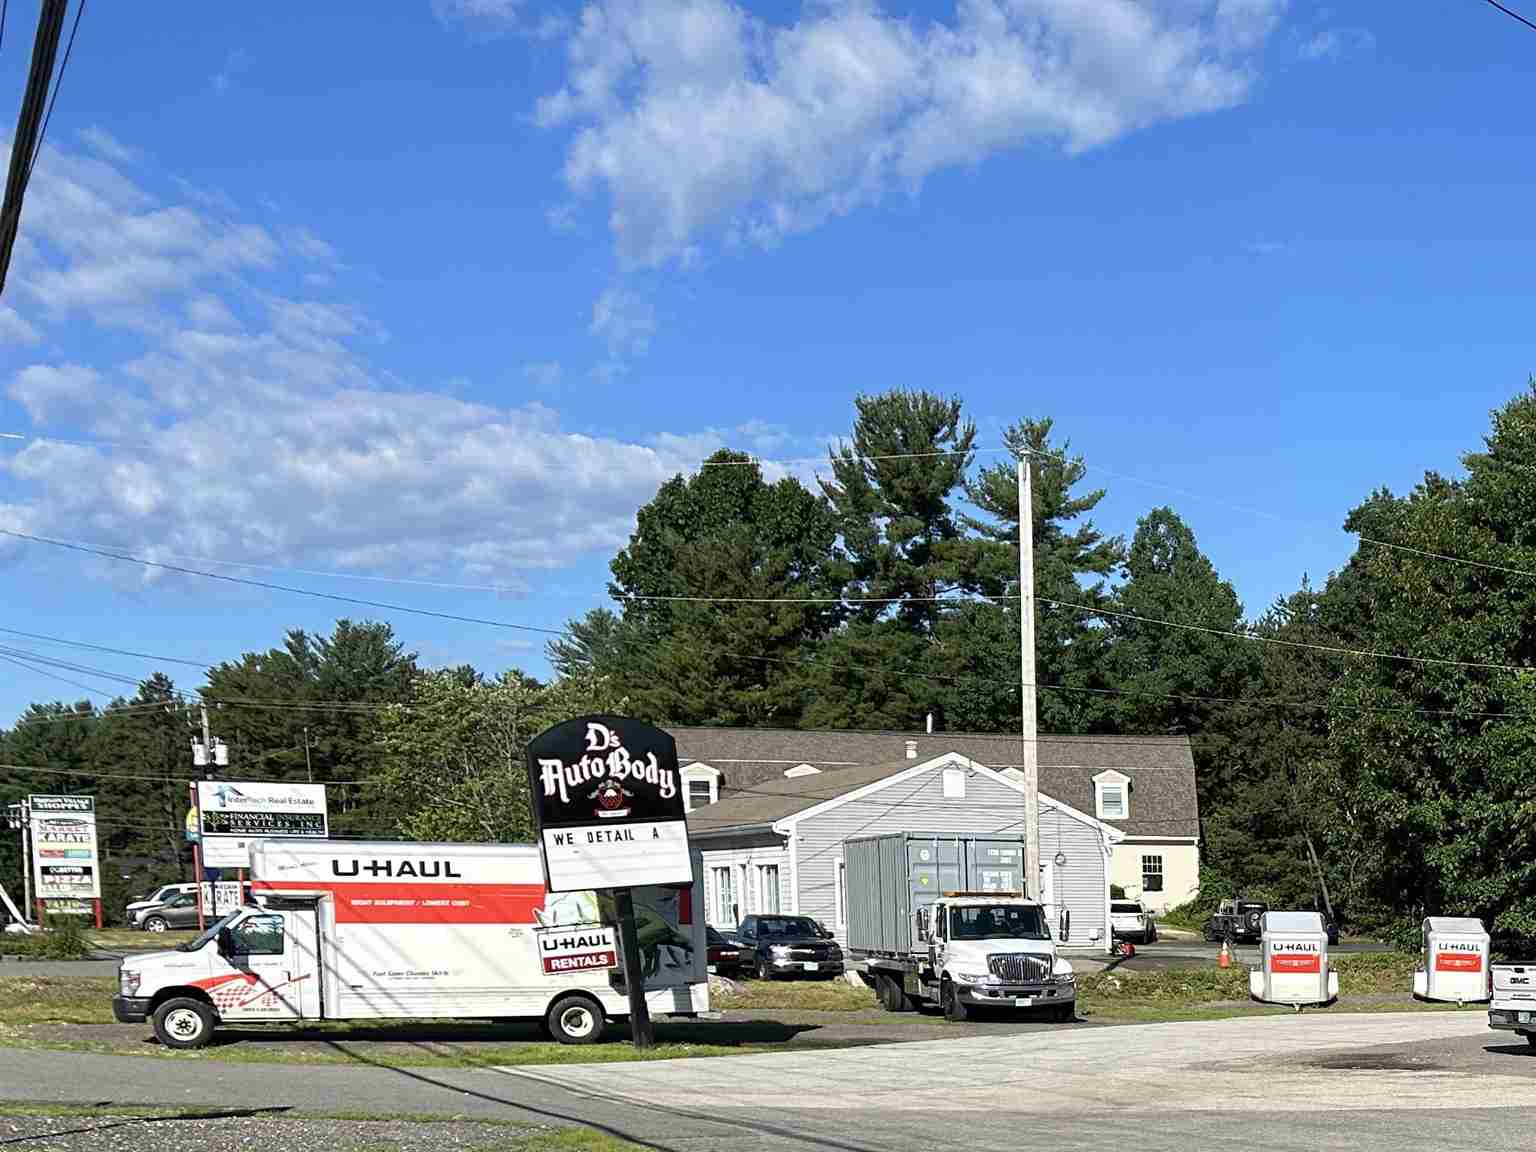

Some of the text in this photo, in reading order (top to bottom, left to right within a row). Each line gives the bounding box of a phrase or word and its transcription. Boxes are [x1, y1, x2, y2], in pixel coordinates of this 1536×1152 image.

[585, 722, 620, 751] D's
[288, 797, 314, 805] Estate
[39, 832, 91, 843] KARATE
[554, 827, 659, 846] WE DETAIL A
[332, 860, 462, 878] U-HAUL
[543, 934, 611, 951] U-HAUL
[1273, 943, 1318, 952] U-HAUL
[1439, 943, 1481, 952] U-HAUL
[551, 954, 609, 970] RENTALS
[1510, 977, 1530, 985] GMC
